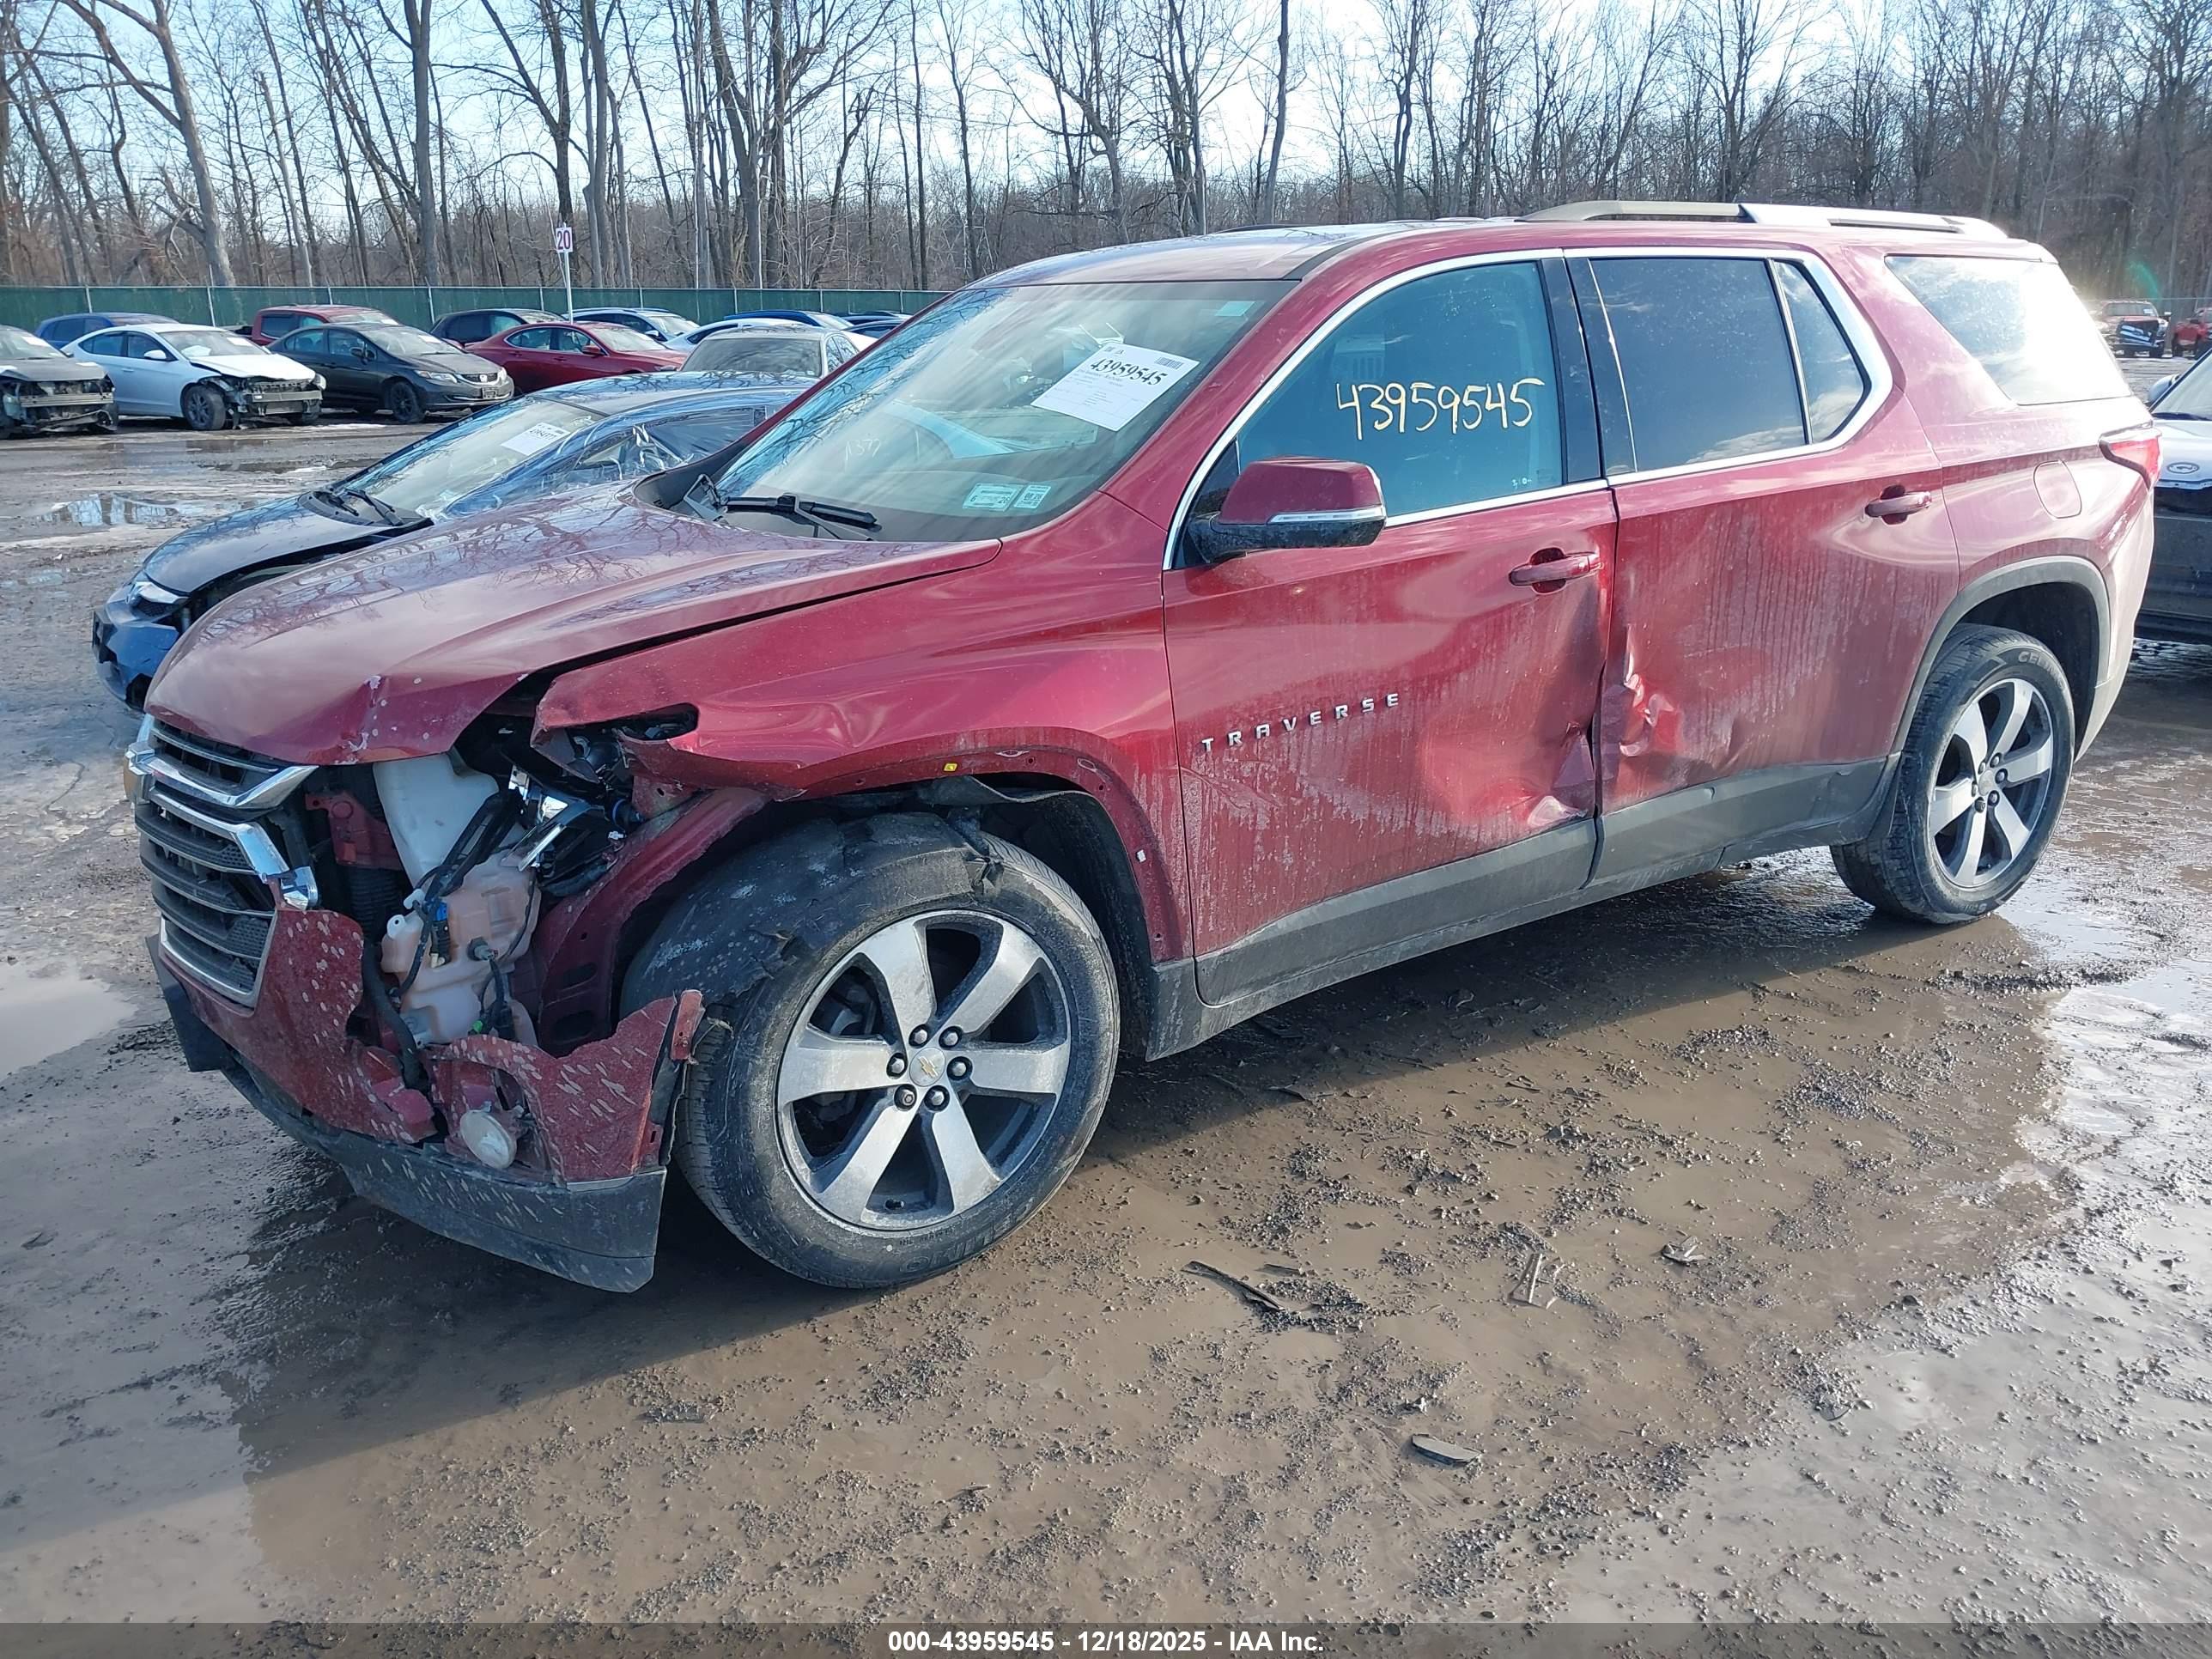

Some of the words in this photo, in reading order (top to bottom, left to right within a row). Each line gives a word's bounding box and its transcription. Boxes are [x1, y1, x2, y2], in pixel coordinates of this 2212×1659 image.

[556, 229, 571, 250] 20
[1090, 357, 1169, 386] 43959545
[1334, 377, 1546, 441] 43959545
[1200, 692, 1400, 753] TRAVERSE
